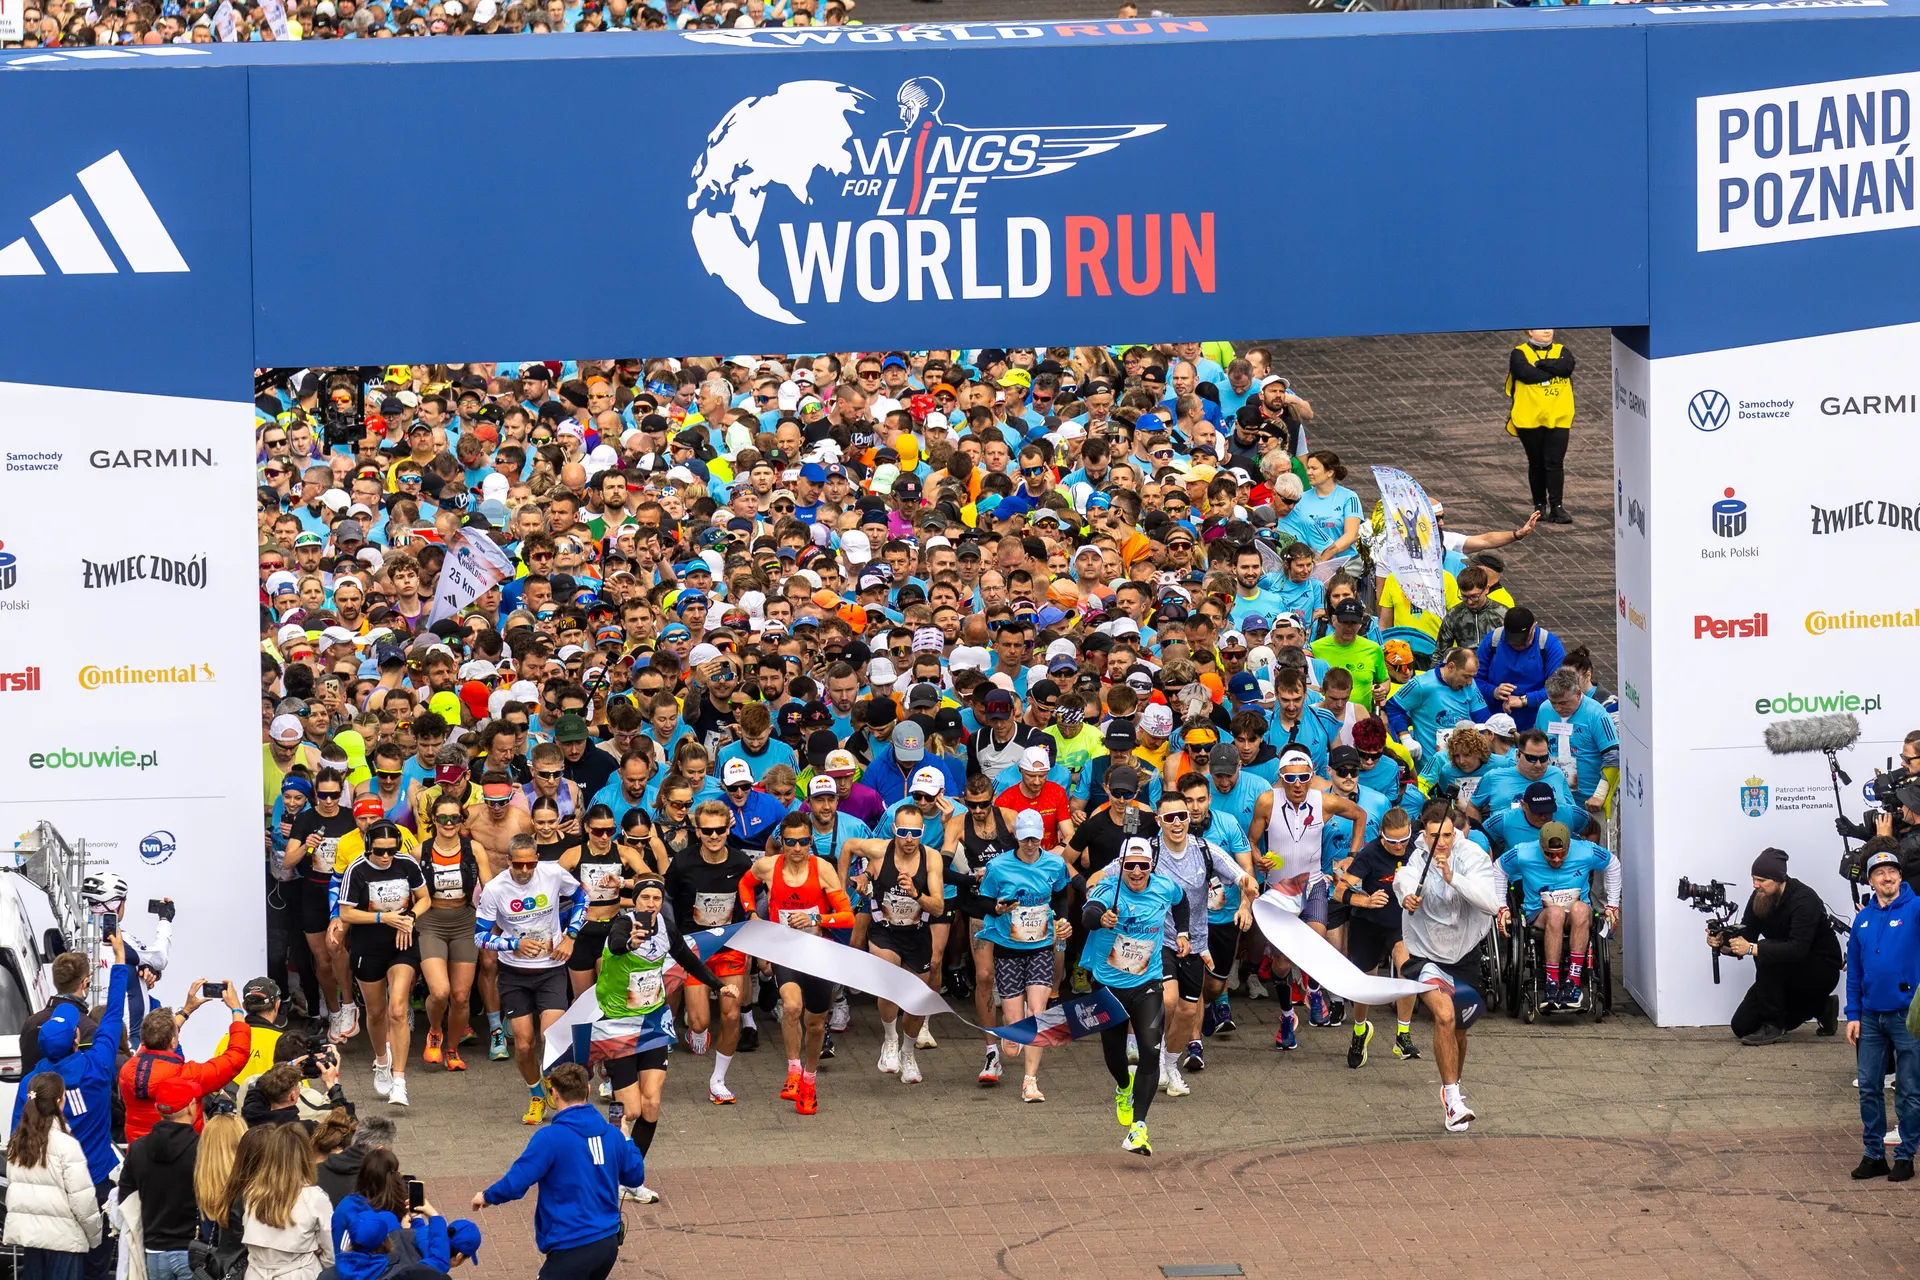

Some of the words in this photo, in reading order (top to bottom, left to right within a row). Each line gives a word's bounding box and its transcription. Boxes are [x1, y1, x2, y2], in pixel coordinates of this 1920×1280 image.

[769, 26, 1045, 46] WORLD
[1053, 21, 1209, 37] RUN
[1718, 88, 1911, 164] POLAND
[853, 121, 1041, 175] WINGS
[841, 178, 883, 197] FOR
[876, 176, 988, 216] LIFE
[1718, 143, 1915, 234] POZNAŃ
[778, 216, 1052, 304] WORLD
[1064, 212, 1216, 297] RUN
[1544, 387, 1560, 397] 245
[1738, 399, 1794, 410] Samochody
[1738, 410, 1790, 420] Dostawcze
[1820, 395, 1915, 416] GARMI
[6, 451, 63, 462] Samochody
[6, 462, 59, 472] Dostawcze
[89, 448, 213, 469] GARMIN
[1811, 499, 1874, 535] ŻYWIEC
[1877, 500, 1920, 532] ZDRÓ
[1701, 548, 1726, 559] Bank
[1730, 547, 1759, 558] Polski
[81, 554, 147, 589] ŻYWIEC
[150, 553, 207, 589] ZDRÓJ
[448, 567, 462, 585] 25
[462, 577, 476, 598] km
[0, 600, 30, 611] Polski
[1694, 612, 1768, 640] Persil
[1804, 608, 1920, 636] Continental
[0, 666, 41, 691] rsil
[78, 664, 197, 690] Continental
[1755, 690, 1882, 715] eobuwie.pl
[29, 746, 158, 771] eobuwie.pl
[379, 895, 401, 904] 18232
[704, 906, 726, 914] 17971
[1021, 919, 1043, 928] 14437
[1120, 950, 1144, 961] 18179
